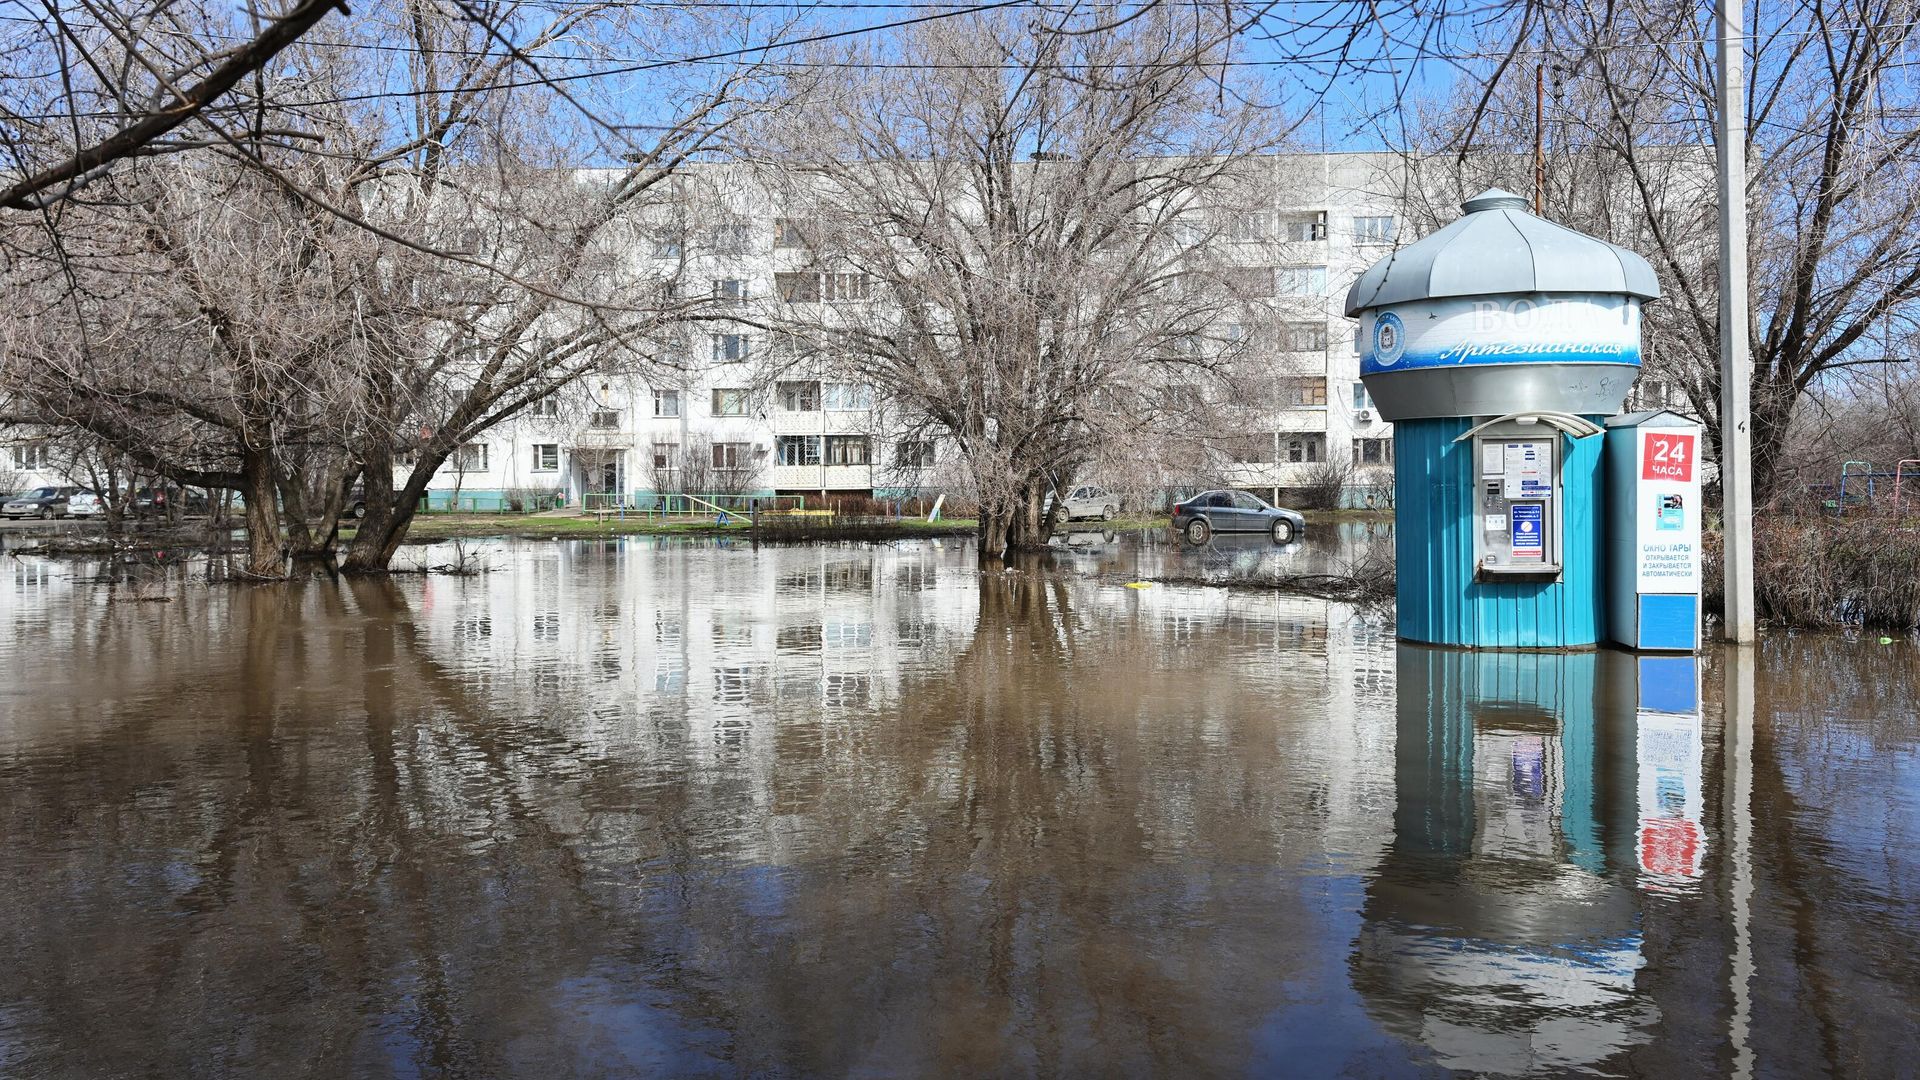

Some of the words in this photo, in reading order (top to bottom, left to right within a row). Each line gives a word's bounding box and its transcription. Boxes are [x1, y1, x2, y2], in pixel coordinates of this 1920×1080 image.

[1440, 340, 1623, 363] Артезианская
[1654, 440, 1685, 463] 24
[1652, 465, 1683, 476] ЧАСА
[1643, 543, 1666, 552] ОКНО
